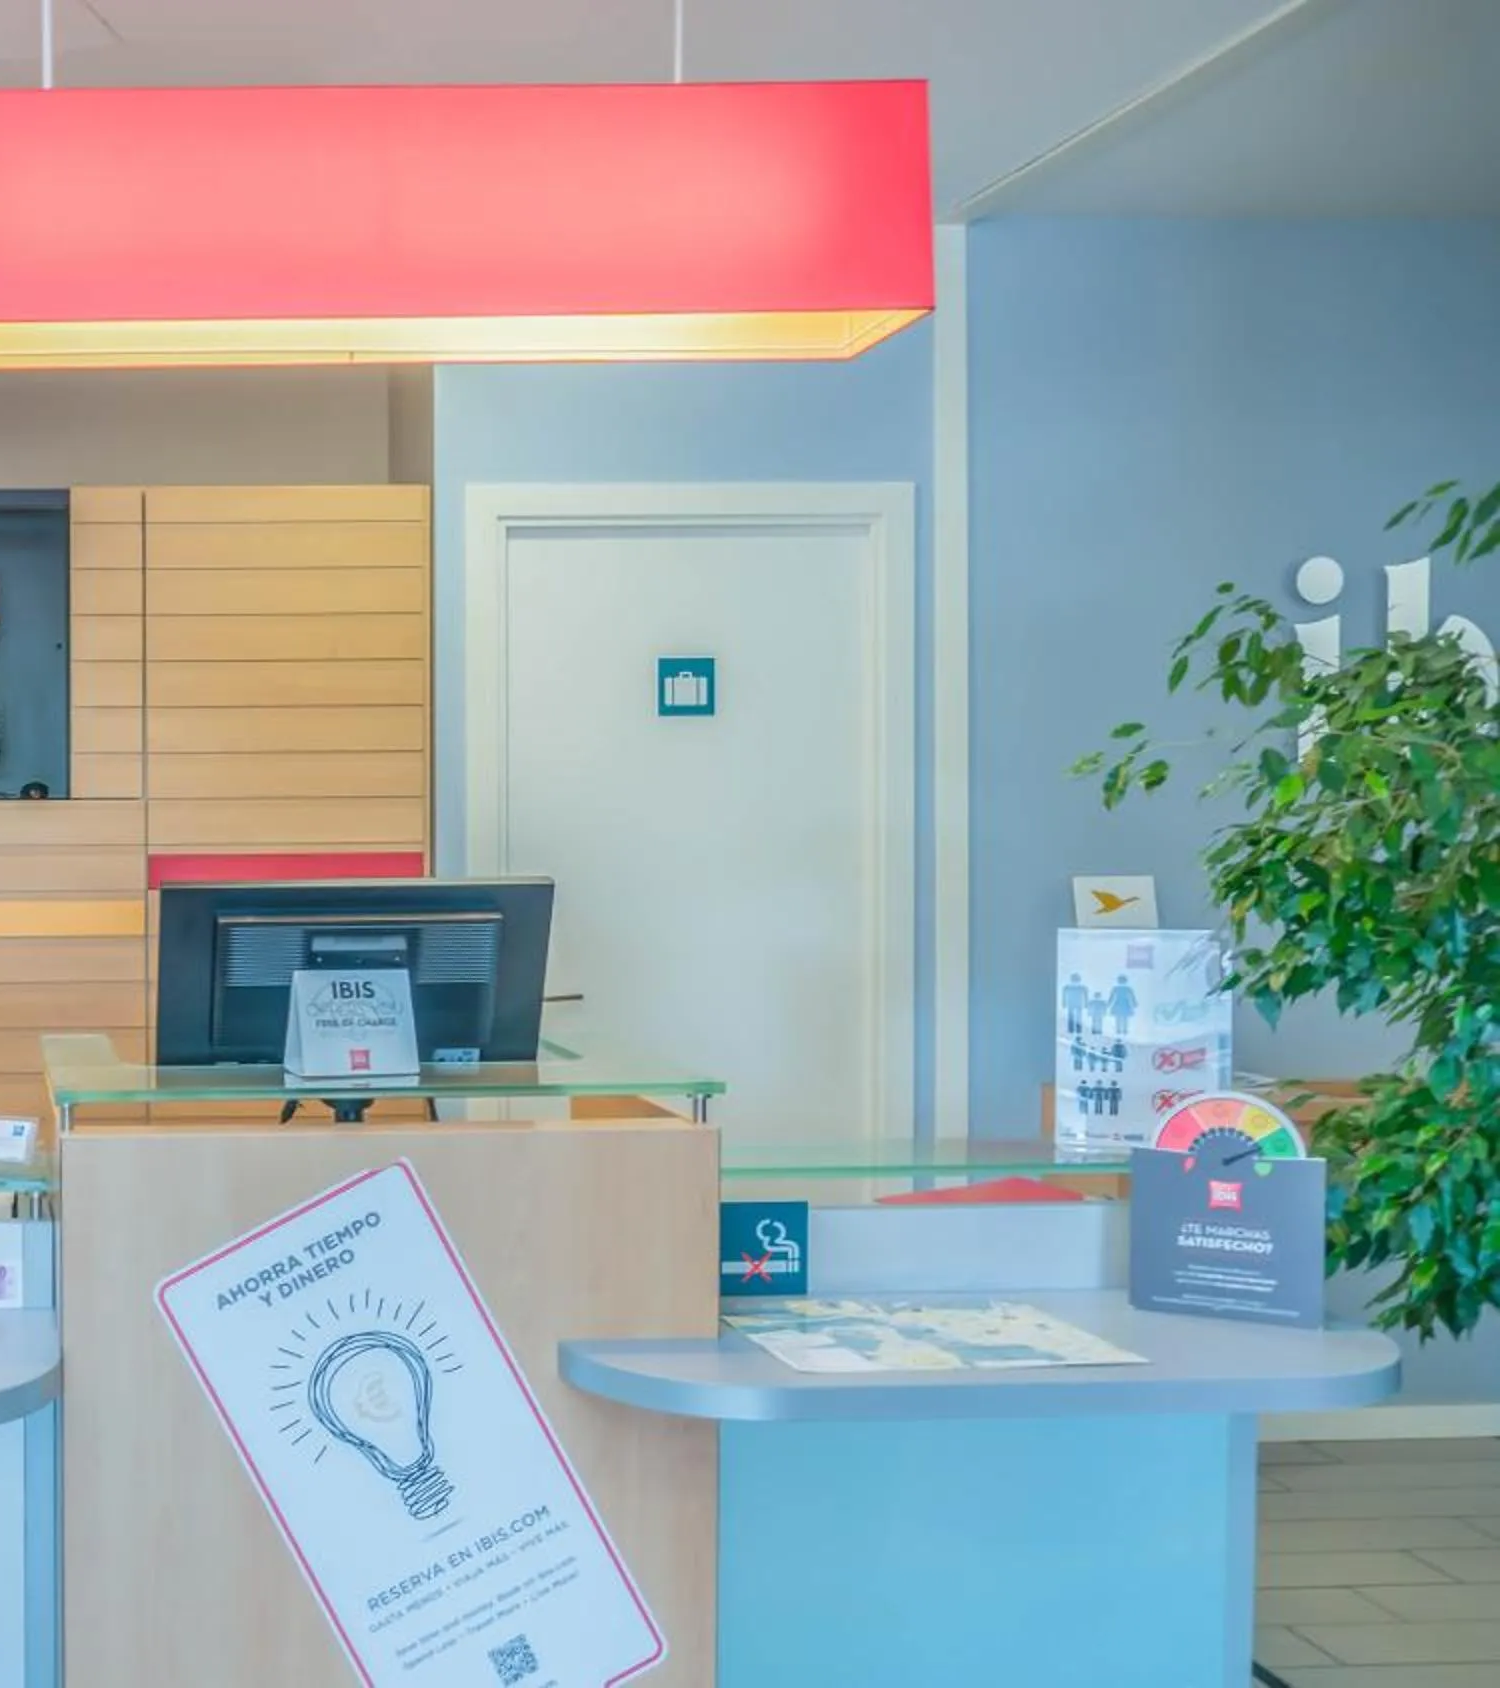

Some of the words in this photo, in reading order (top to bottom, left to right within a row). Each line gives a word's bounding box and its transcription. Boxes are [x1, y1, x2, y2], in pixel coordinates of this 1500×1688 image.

[331, 981, 375, 999] IBIS
[216, 1255, 302, 1310] AHORRA
[304, 1212, 380, 1258] TIEMPO
[258, 1292, 274, 1308] Y
[278, 1249, 354, 1298] DINERO
[367, 1563, 445, 1611] RESERVA
[448, 1547, 473, 1568] EN
[475, 1505, 549, 1552] IBIS.COM
